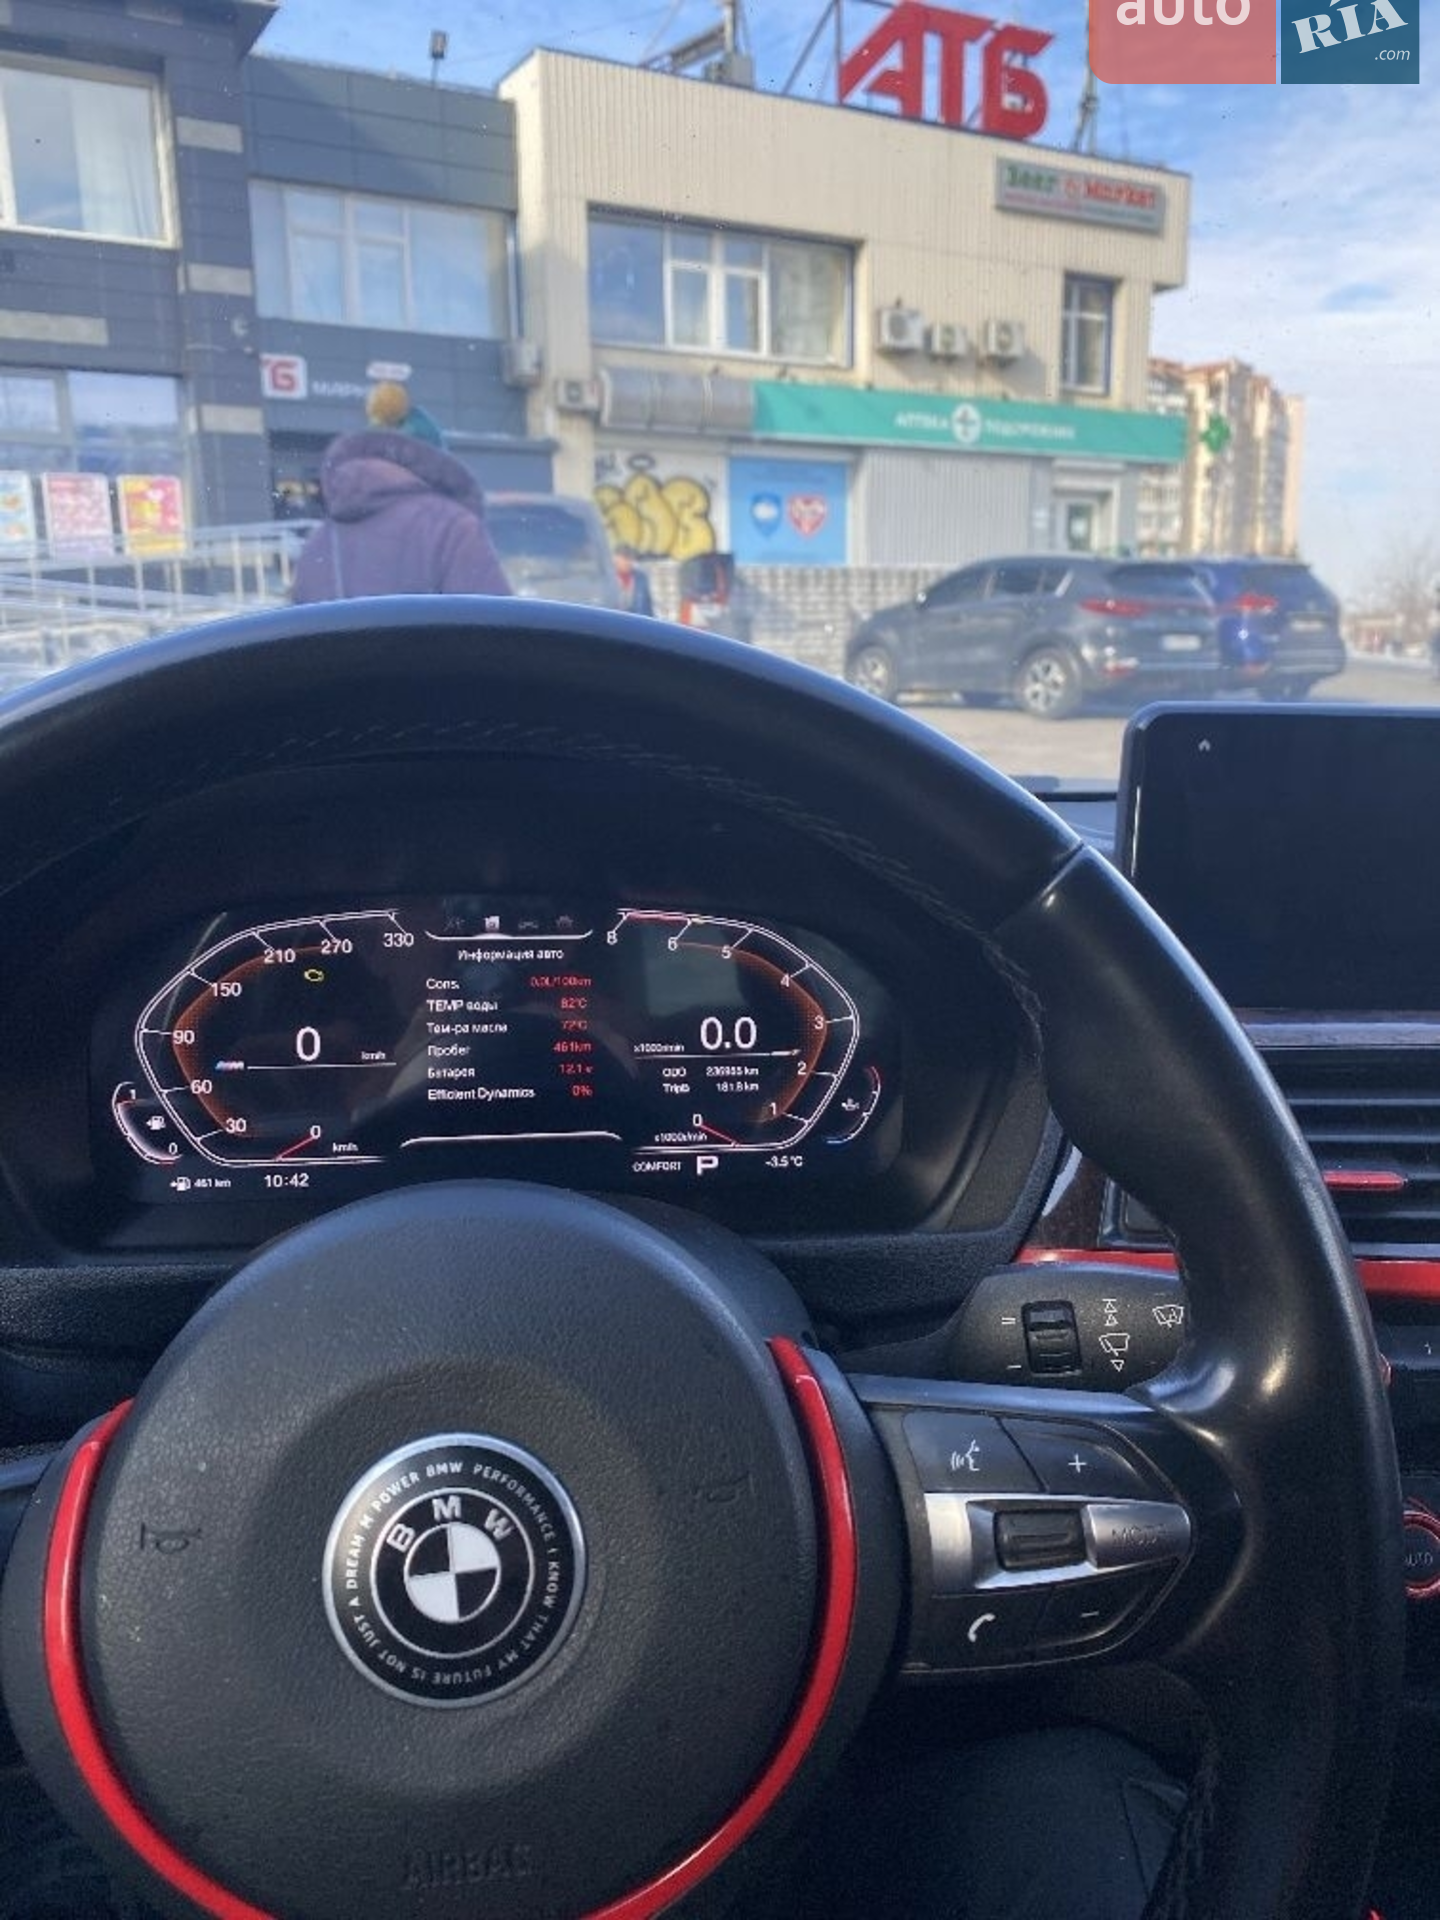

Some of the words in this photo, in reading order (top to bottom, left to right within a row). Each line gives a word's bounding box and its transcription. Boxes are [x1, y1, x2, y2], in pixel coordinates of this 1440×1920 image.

[838, 2, 1056, 140] АТБ
[384, 933, 414, 948] 330
[606, 932, 618, 945] 8
[667, 938, 678, 951] 6
[321, 939, 352, 954] 270
[721, 947, 733, 959] 5
[263, 949, 296, 963] 210
[458, 948, 534, 963] Информация
[536, 950, 565, 961] авто
[780, 975, 791, 988] 4
[211, 982, 242, 997] 150
[426, 1000, 464, 1012] TEMP
[472, 1023, 508, 1034] масла
[814, 1016, 825, 1030] 3
[172, 1030, 195, 1044] 90
[699, 1016, 757, 1051] 0.0
[295, 1026, 321, 1061] 0
[744, 1065, 760, 1076] km
[797, 1062, 808, 1075] 2
[190, 1080, 212, 1094] 60
[427, 1088, 476, 1101] Efficient
[477, 1087, 537, 1102] Dynamics
[744, 1082, 760, 1093] km
[769, 1102, 778, 1115] 1
[225, 1118, 247, 1133] 30
[693, 1114, 703, 1127] 0
[310, 1125, 321, 1138] 0
[168, 1142, 178, 1154] 0
[632, 1161, 681, 1172] COMFORT
[696, 1155, 719, 1175] P
[194, 1178, 212, 1188] 461
[214, 1178, 231, 1188] km
[264, 1173, 310, 1188] 10:42
[426, 1461, 463, 1478] BMW
[373, 1472, 421, 1513] POWER
[473, 1463, 557, 1542] PERFORMANCE
[359, 1515, 375, 1531] M
[386, 1495, 515, 1553] BMW
[345, 1534, 367, 1590] DREAM
[543, 1561, 561, 1609] KNOW
[348, 1597, 360, 1608] A
[353, 1615, 382, 1648] JUST
[519, 1614, 548, 1651] THAT
[379, 1650, 406, 1673] NOT
[499, 1650, 519, 1670] MY
[411, 1667, 426, 1681] IS
[432, 1664, 493, 1685] FUTURE
